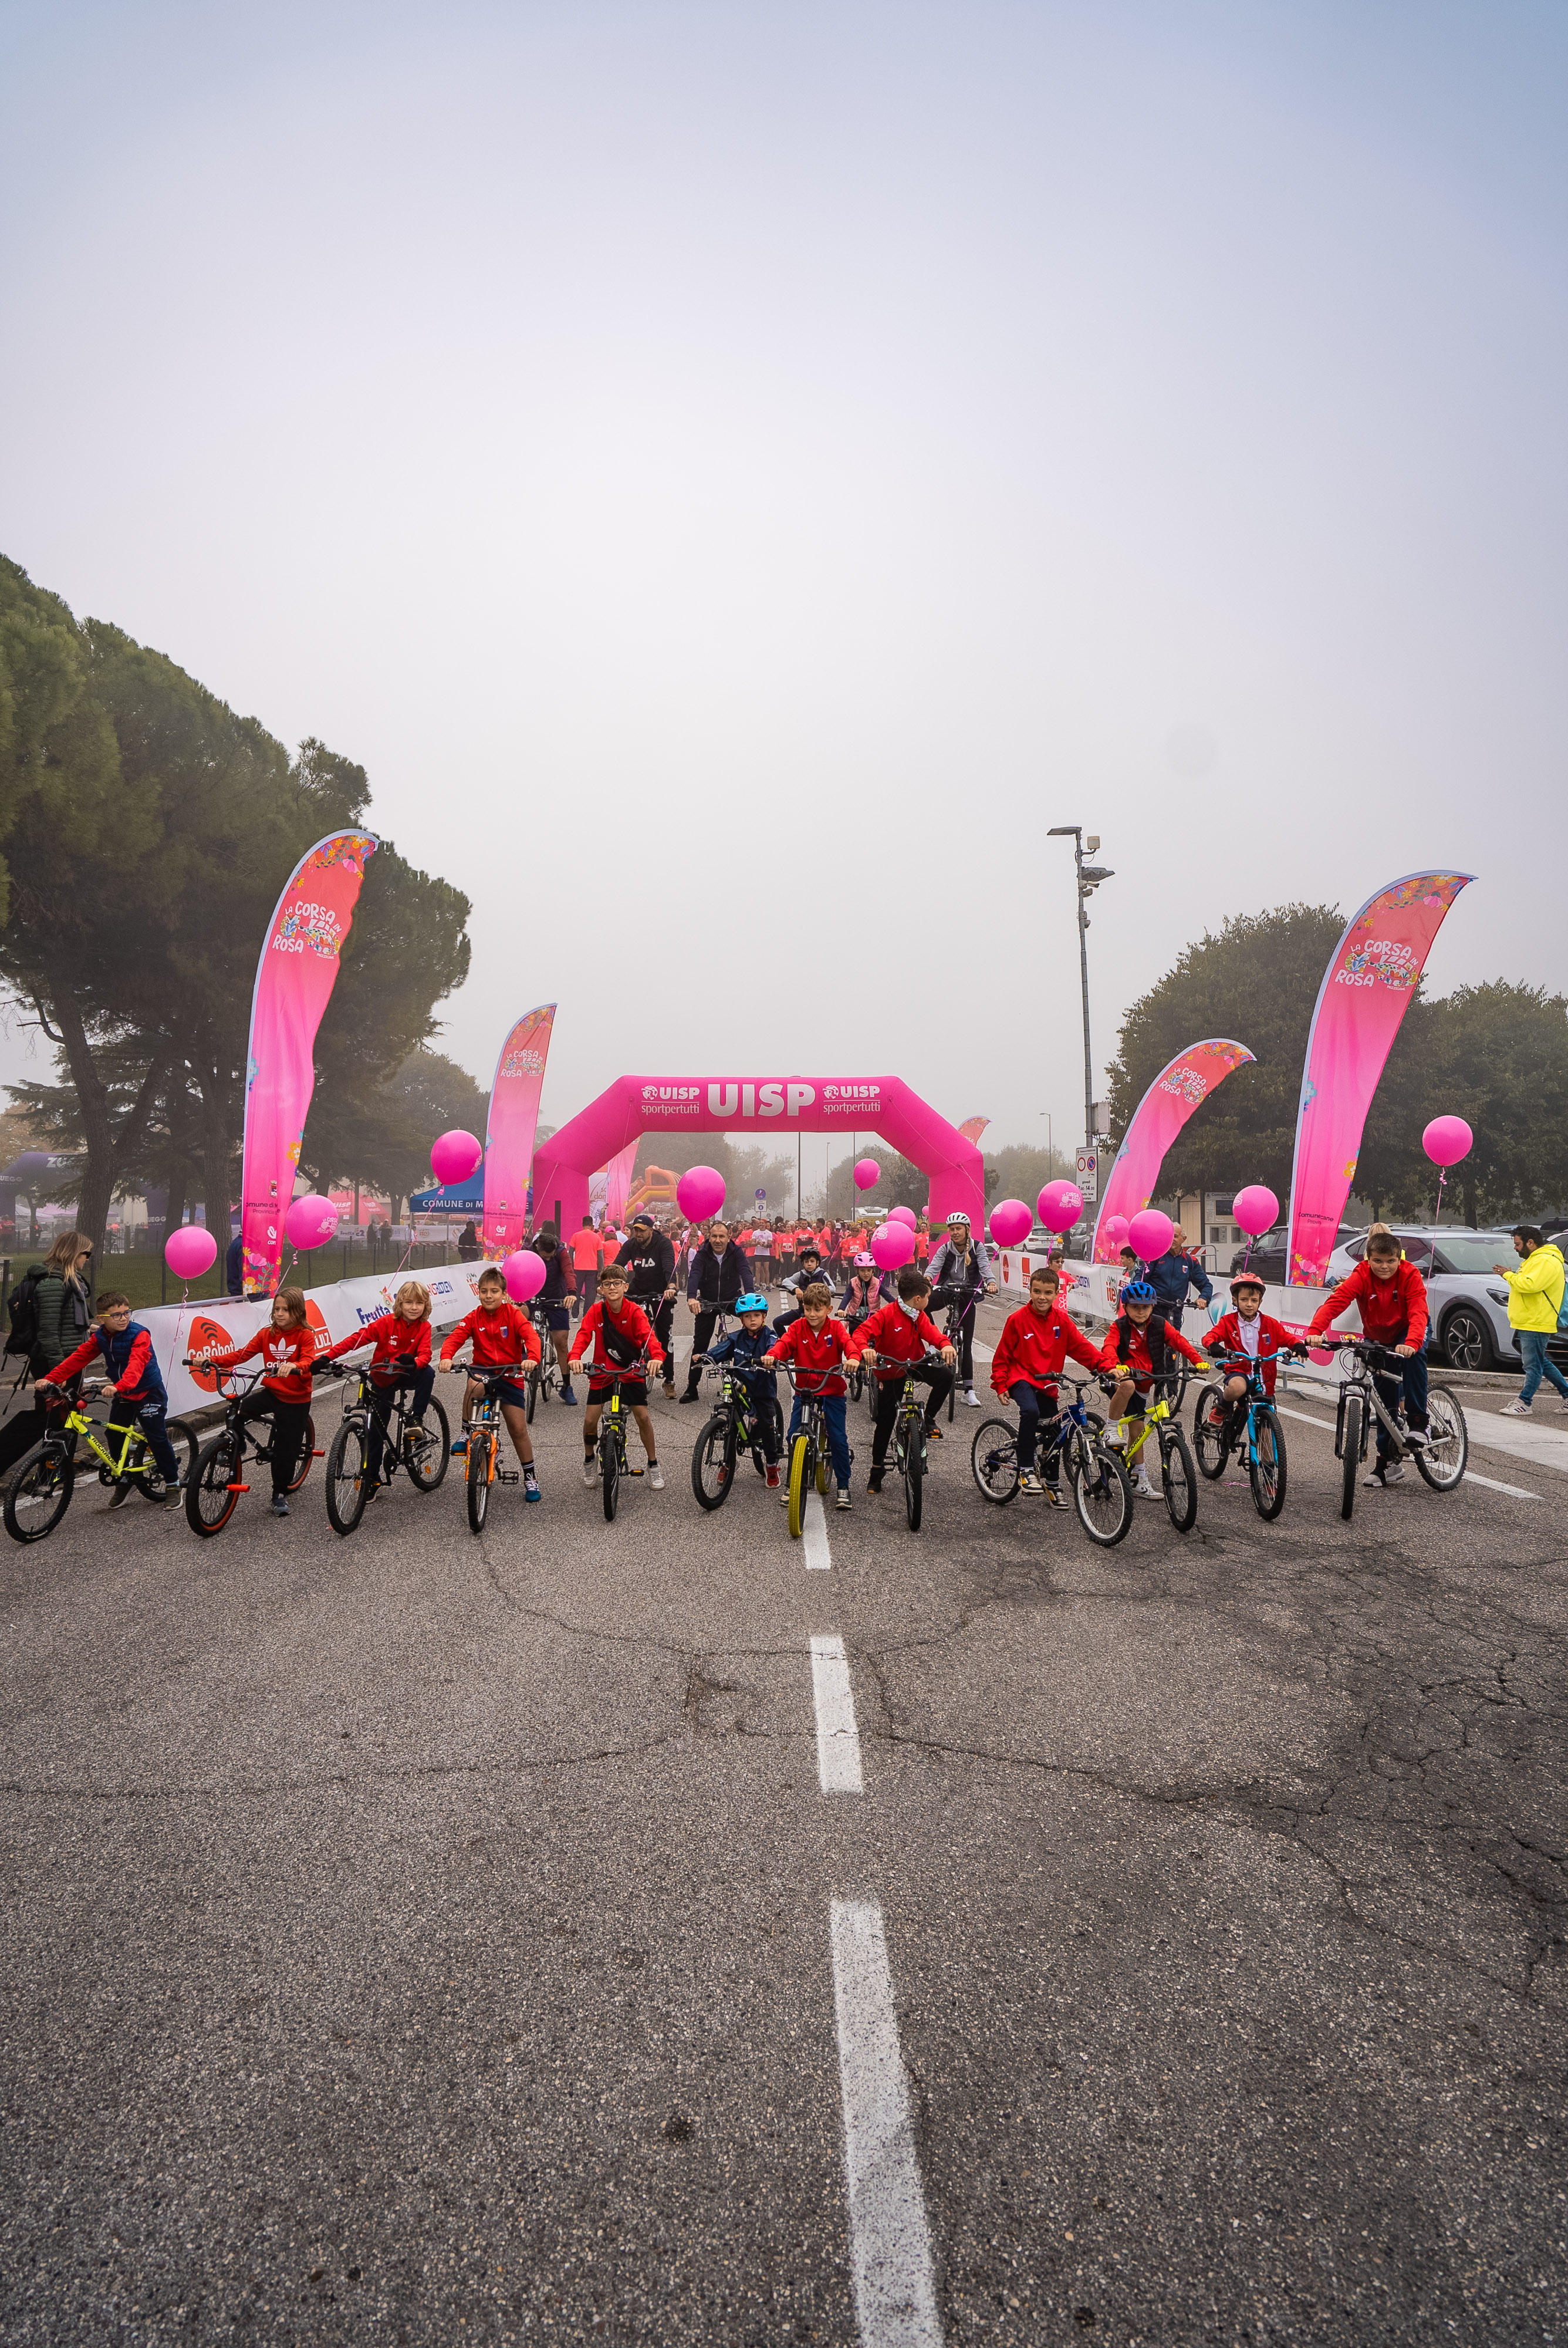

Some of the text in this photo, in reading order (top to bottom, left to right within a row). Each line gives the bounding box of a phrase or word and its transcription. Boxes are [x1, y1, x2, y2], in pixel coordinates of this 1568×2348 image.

[285, 900, 335, 925] LA CORSA
[333, 923, 342, 932] IN
[272, 934, 304, 953] ROSA
[1364, 939, 1412, 960] CORSA
[1410, 957, 1419, 966] IN
[1335, 969, 1375, 987] ROSA
[513, 1050, 539, 1058] CORSA
[501, 1069, 522, 1077] ROSA
[1182, 1067, 1207, 1087] CORSA
[659, 1087, 699, 1099] UISP
[840, 1085, 880, 1098] UISP
[1159, 1080, 1181, 1096] ROSA
[708, 1084, 816, 1116] UISP
[641, 1104, 699, 1116] sportpertutti
[823, 1102, 880, 1115] sportpertutti
[634, 1257, 655, 1267] FILA
[356, 1303, 391, 1325] Frutta
[266, 1359, 287, 1368] adid
[92, 1438, 119, 1469] ROCKRIDER
